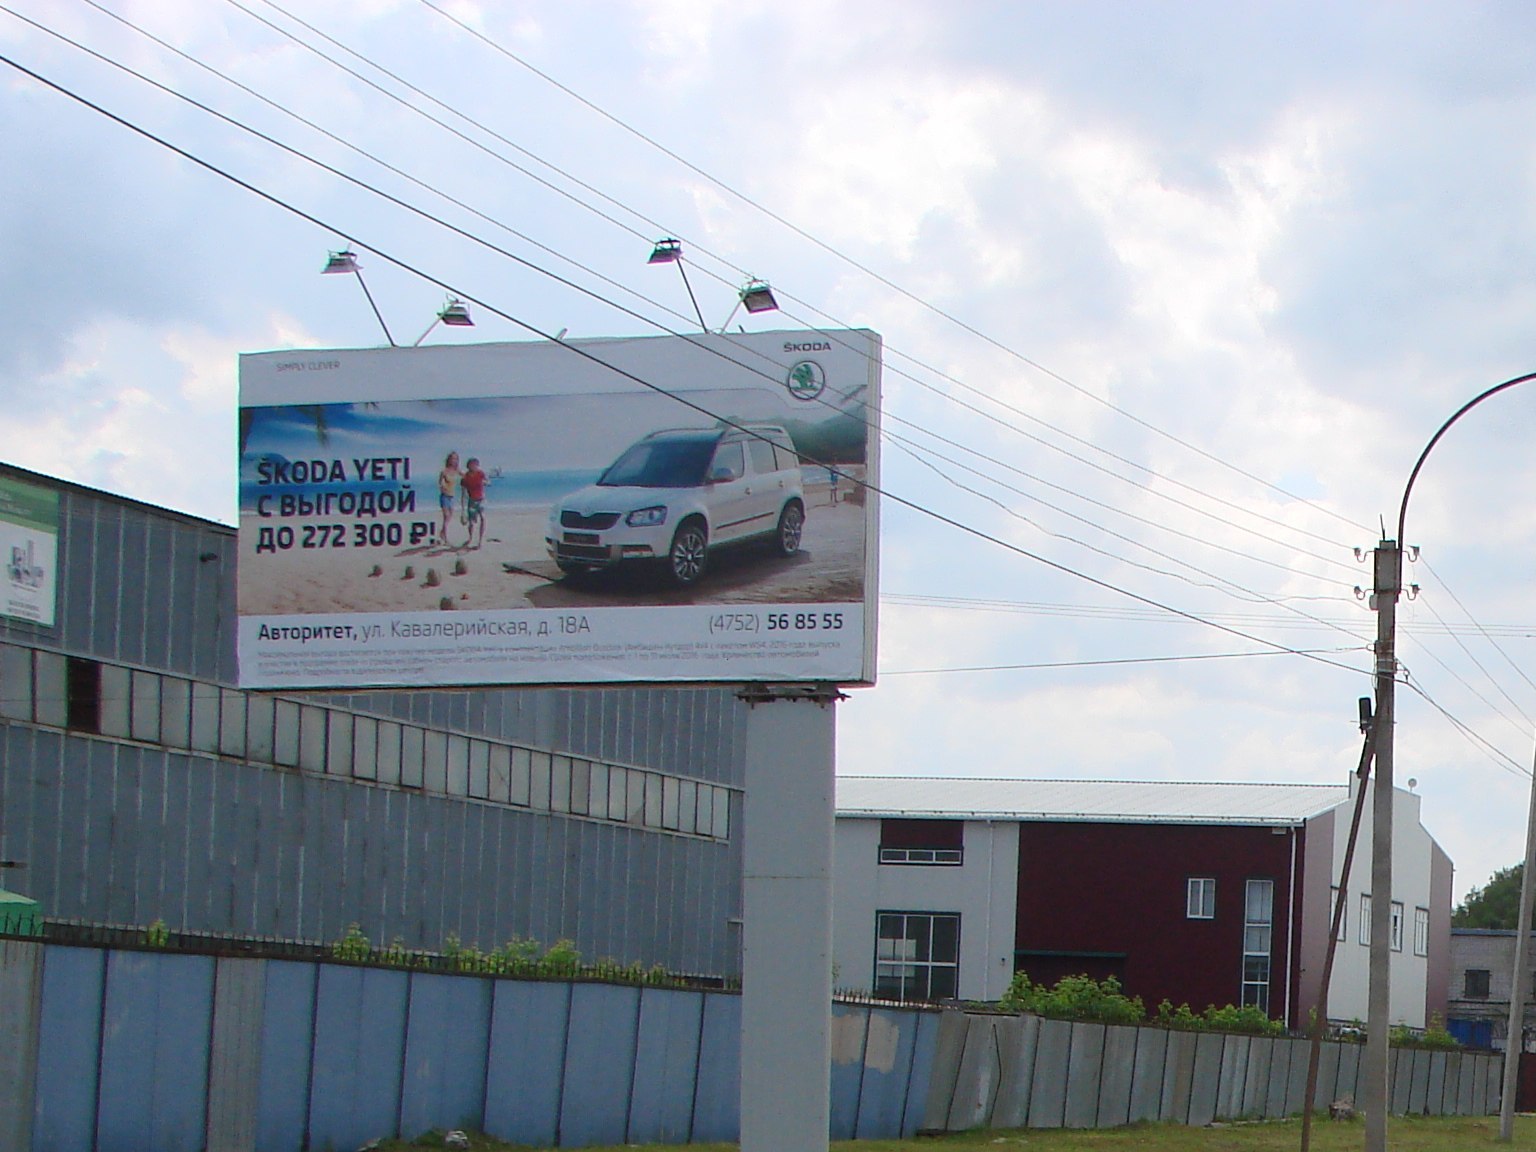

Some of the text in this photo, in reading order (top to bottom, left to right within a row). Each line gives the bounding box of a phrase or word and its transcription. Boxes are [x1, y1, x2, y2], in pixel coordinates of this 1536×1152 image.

[783, 341, 832, 353] ŠKODA
[257, 457, 411, 485] ŠKODA YETI
[257, 485, 416, 519] С ВЫГОДОЙ
[256, 525, 295, 554] ДО
[302, 524, 346, 549] 272
[354, 522, 403, 548] 300
[258, 615, 591, 644] Авторитет, ул. Кавалерийская, д. 18А
[708, 613, 844, 635] (4752) 56 85 55
